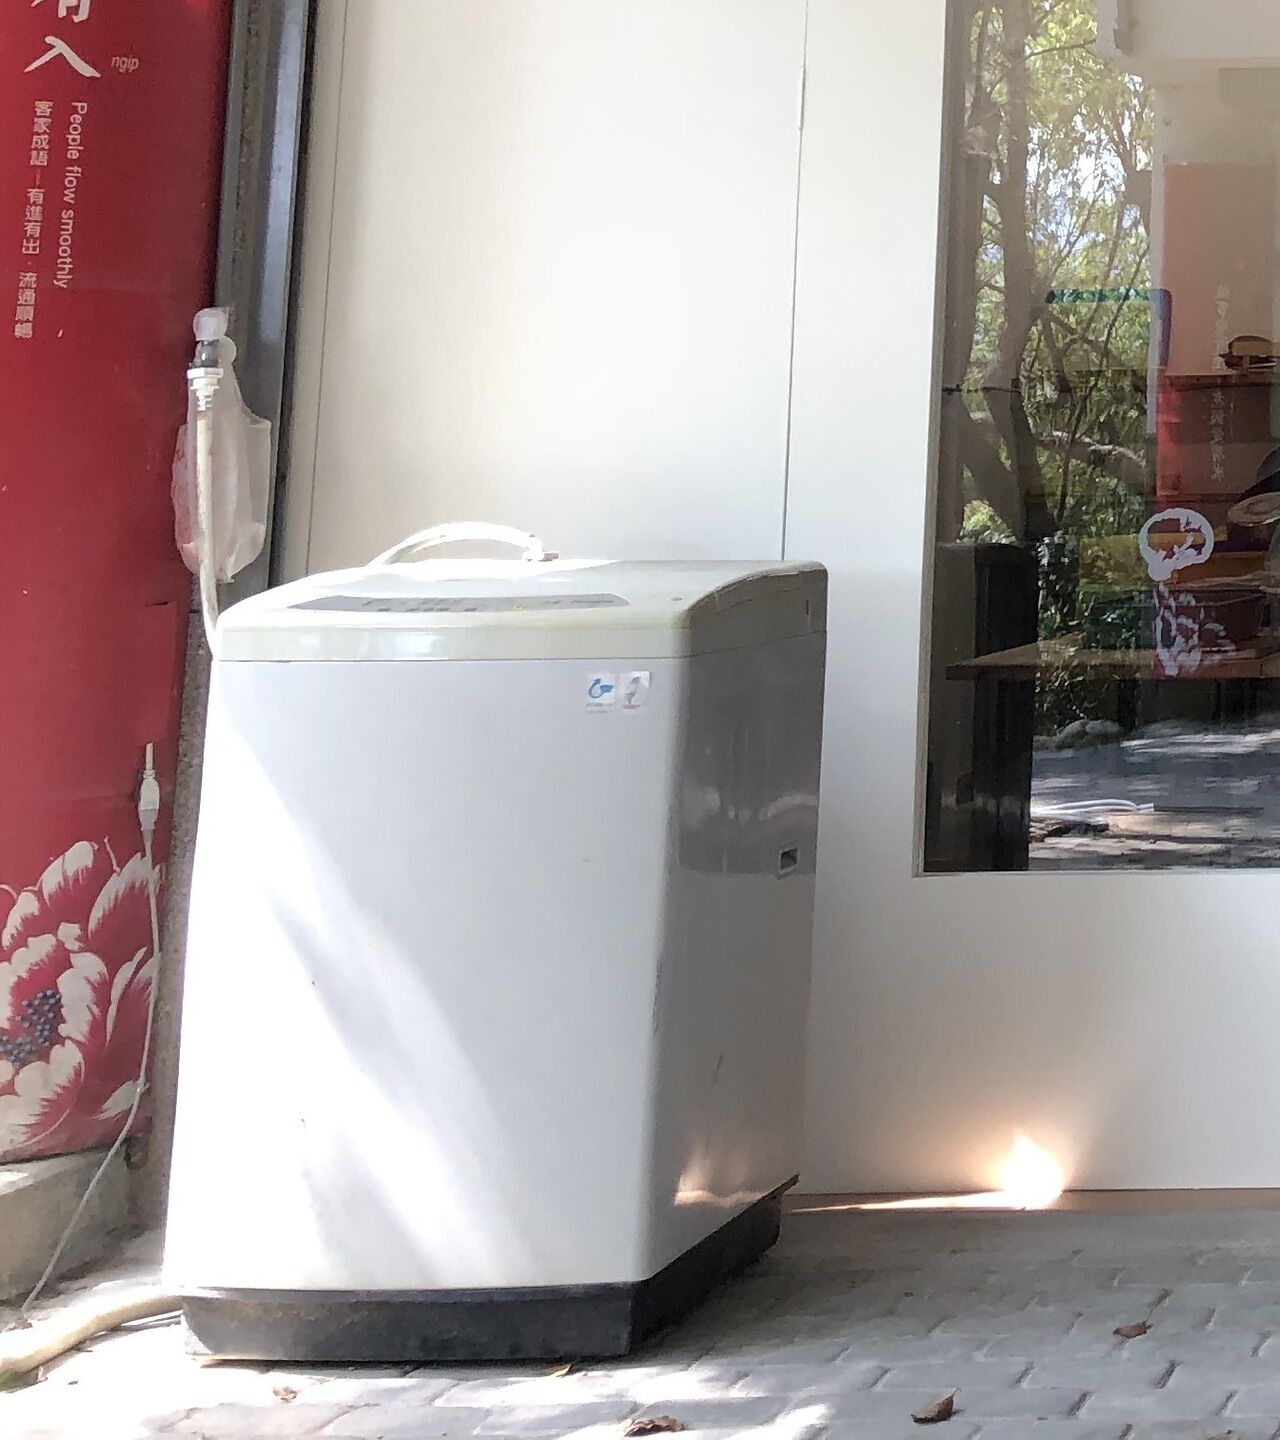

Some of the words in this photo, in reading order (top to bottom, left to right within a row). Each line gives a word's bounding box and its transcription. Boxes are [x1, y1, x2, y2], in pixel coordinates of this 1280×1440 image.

[110, 54, 140, 74] ngip
[67, 102, 88, 160] People
[63, 165, 83, 205] flow
[53, 209, 75, 289] smoothly
